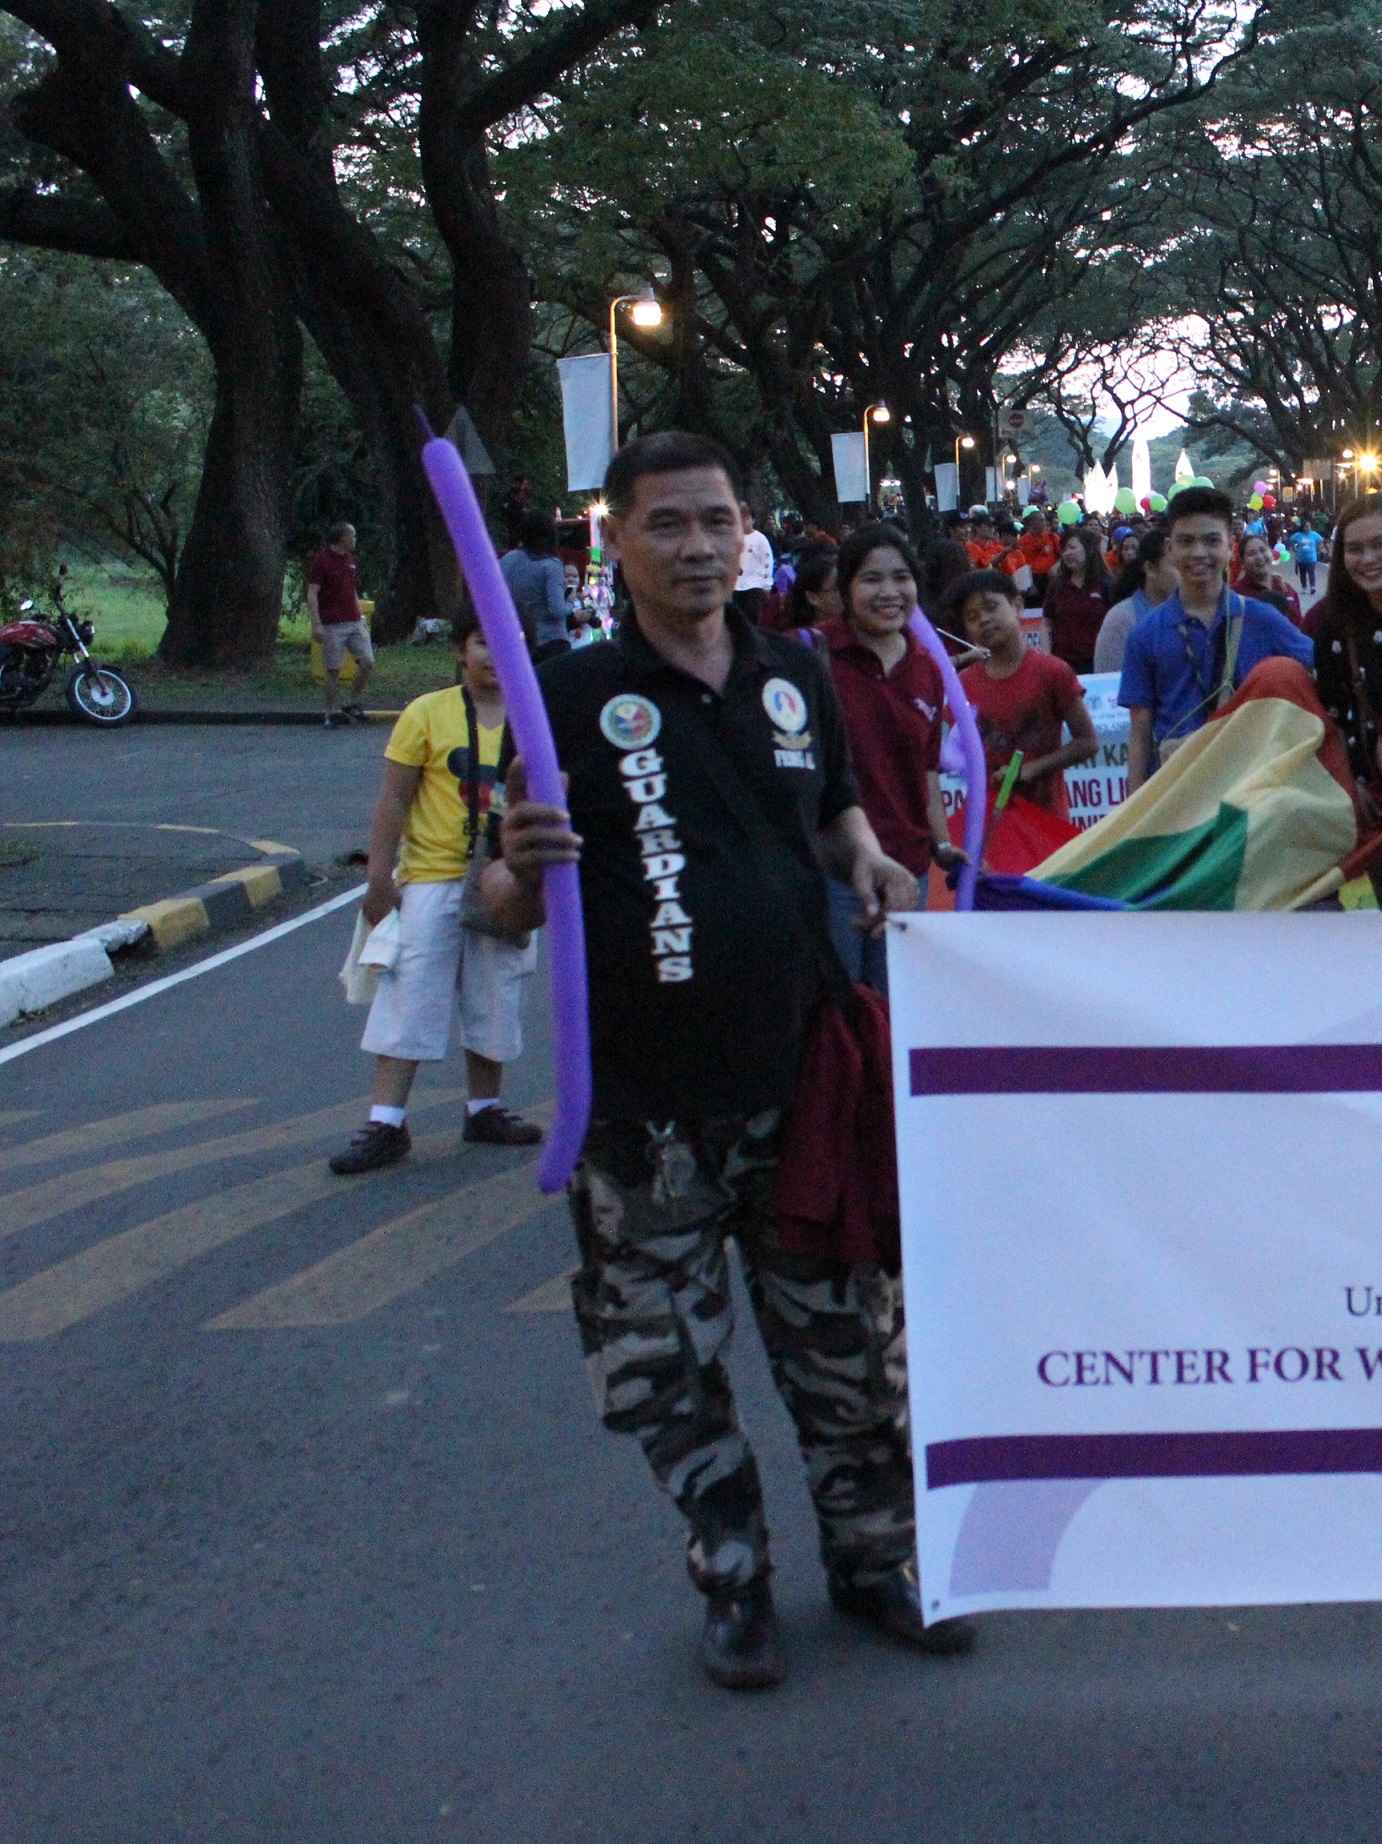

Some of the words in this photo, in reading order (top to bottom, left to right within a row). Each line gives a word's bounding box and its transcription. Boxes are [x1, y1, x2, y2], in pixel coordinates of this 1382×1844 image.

[1107, 777, 1129, 806] LI
[617, 748, 694, 983] GUARDIANS
[1037, 1348, 1234, 1388] CENTER
[1246, 1346, 1345, 1384] FOR
